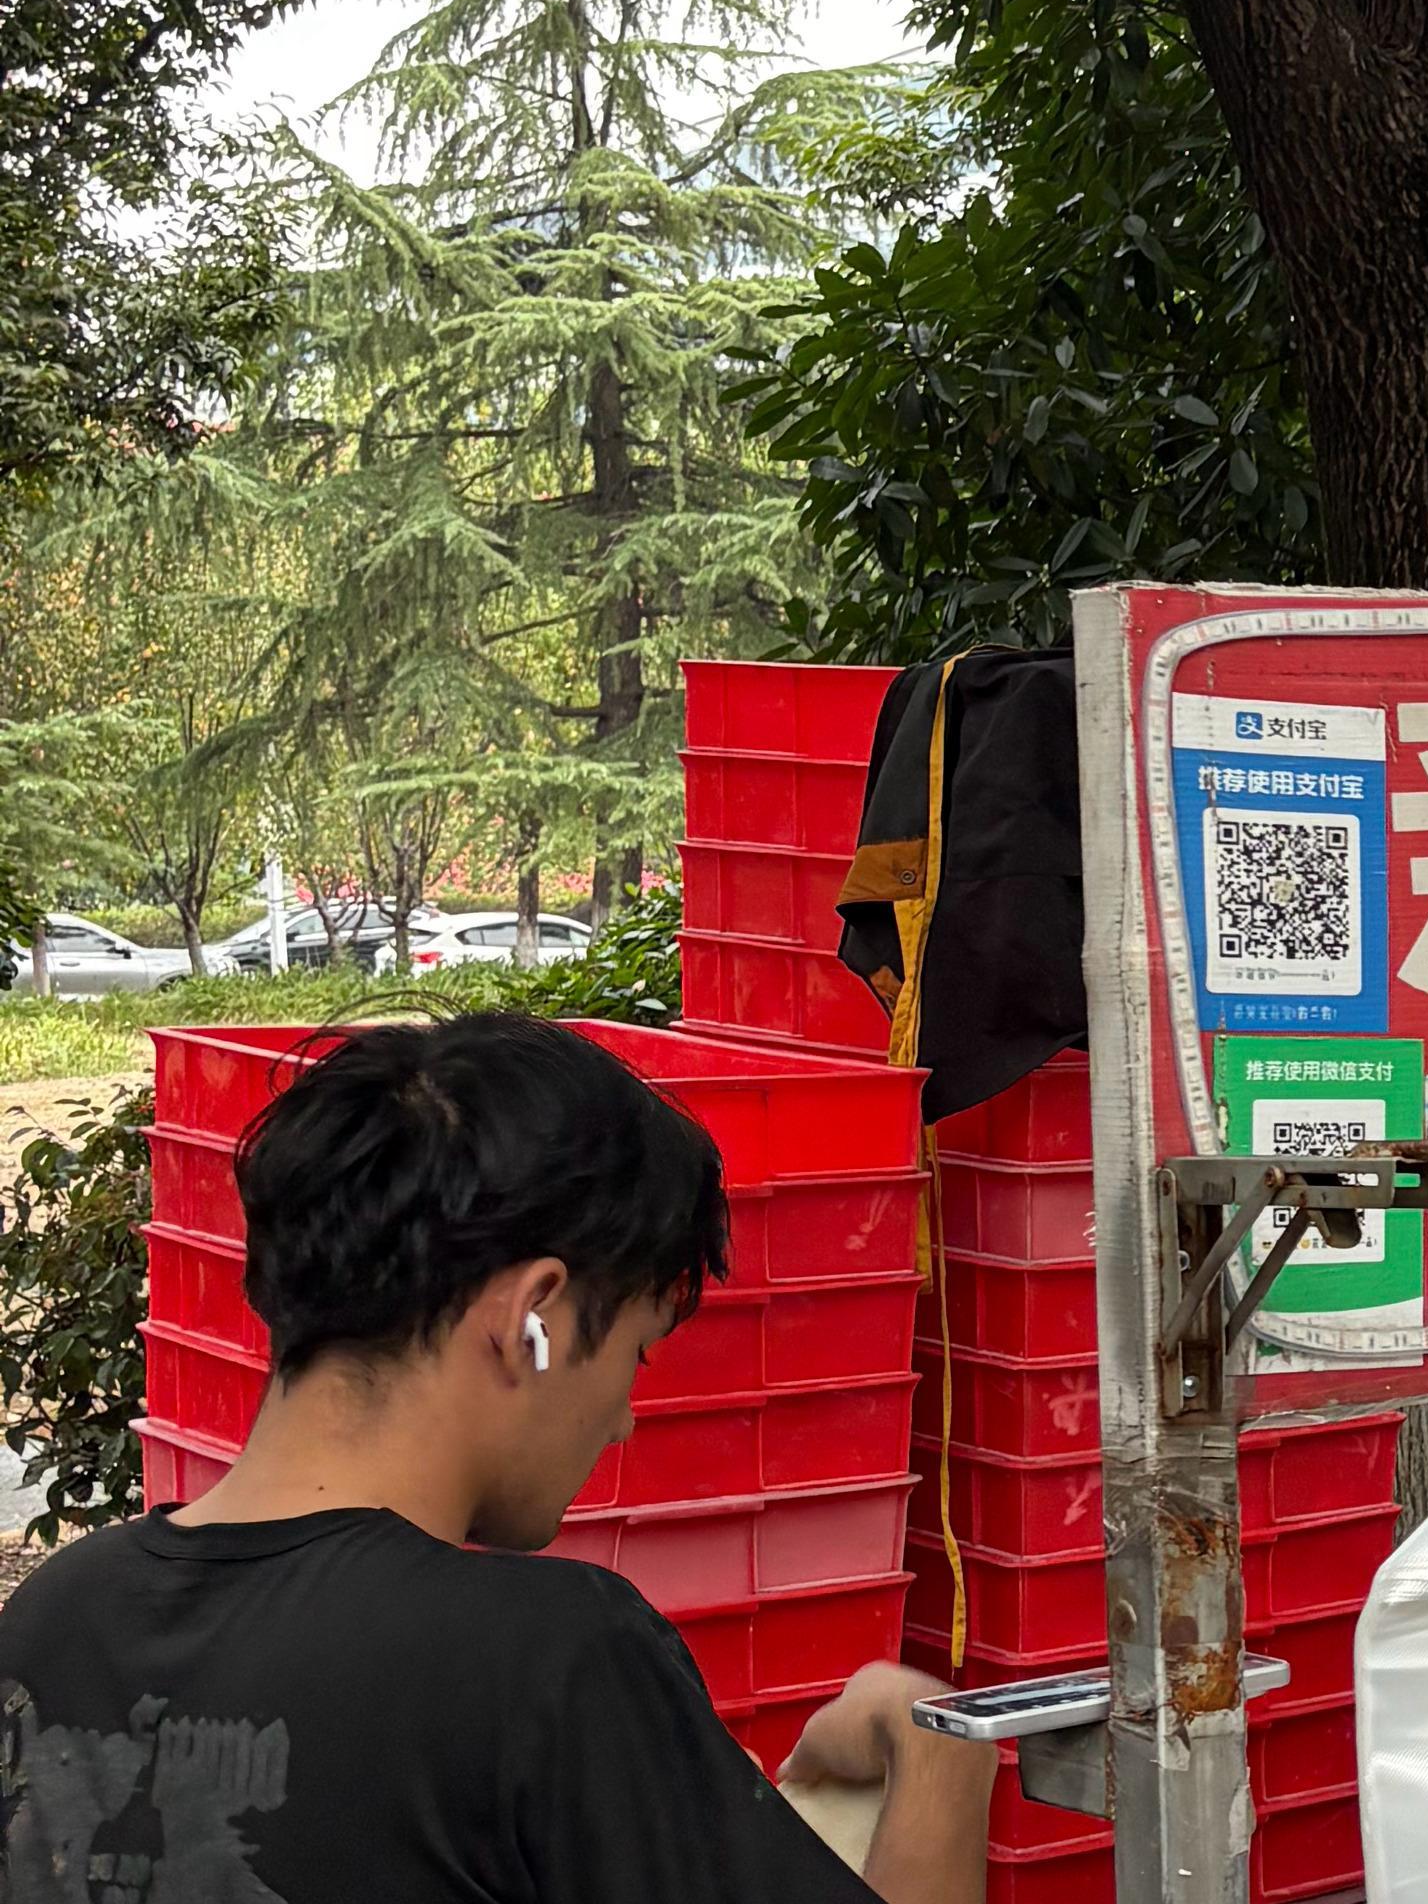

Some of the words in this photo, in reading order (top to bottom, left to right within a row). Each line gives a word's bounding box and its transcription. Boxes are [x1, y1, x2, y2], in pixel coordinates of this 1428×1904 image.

[1266, 718, 1327, 740] 支付宝
[1198, 765, 1365, 800] 推荐使用支付宝
[1245, 1059, 1395, 1082] 推荐使用微信支付
